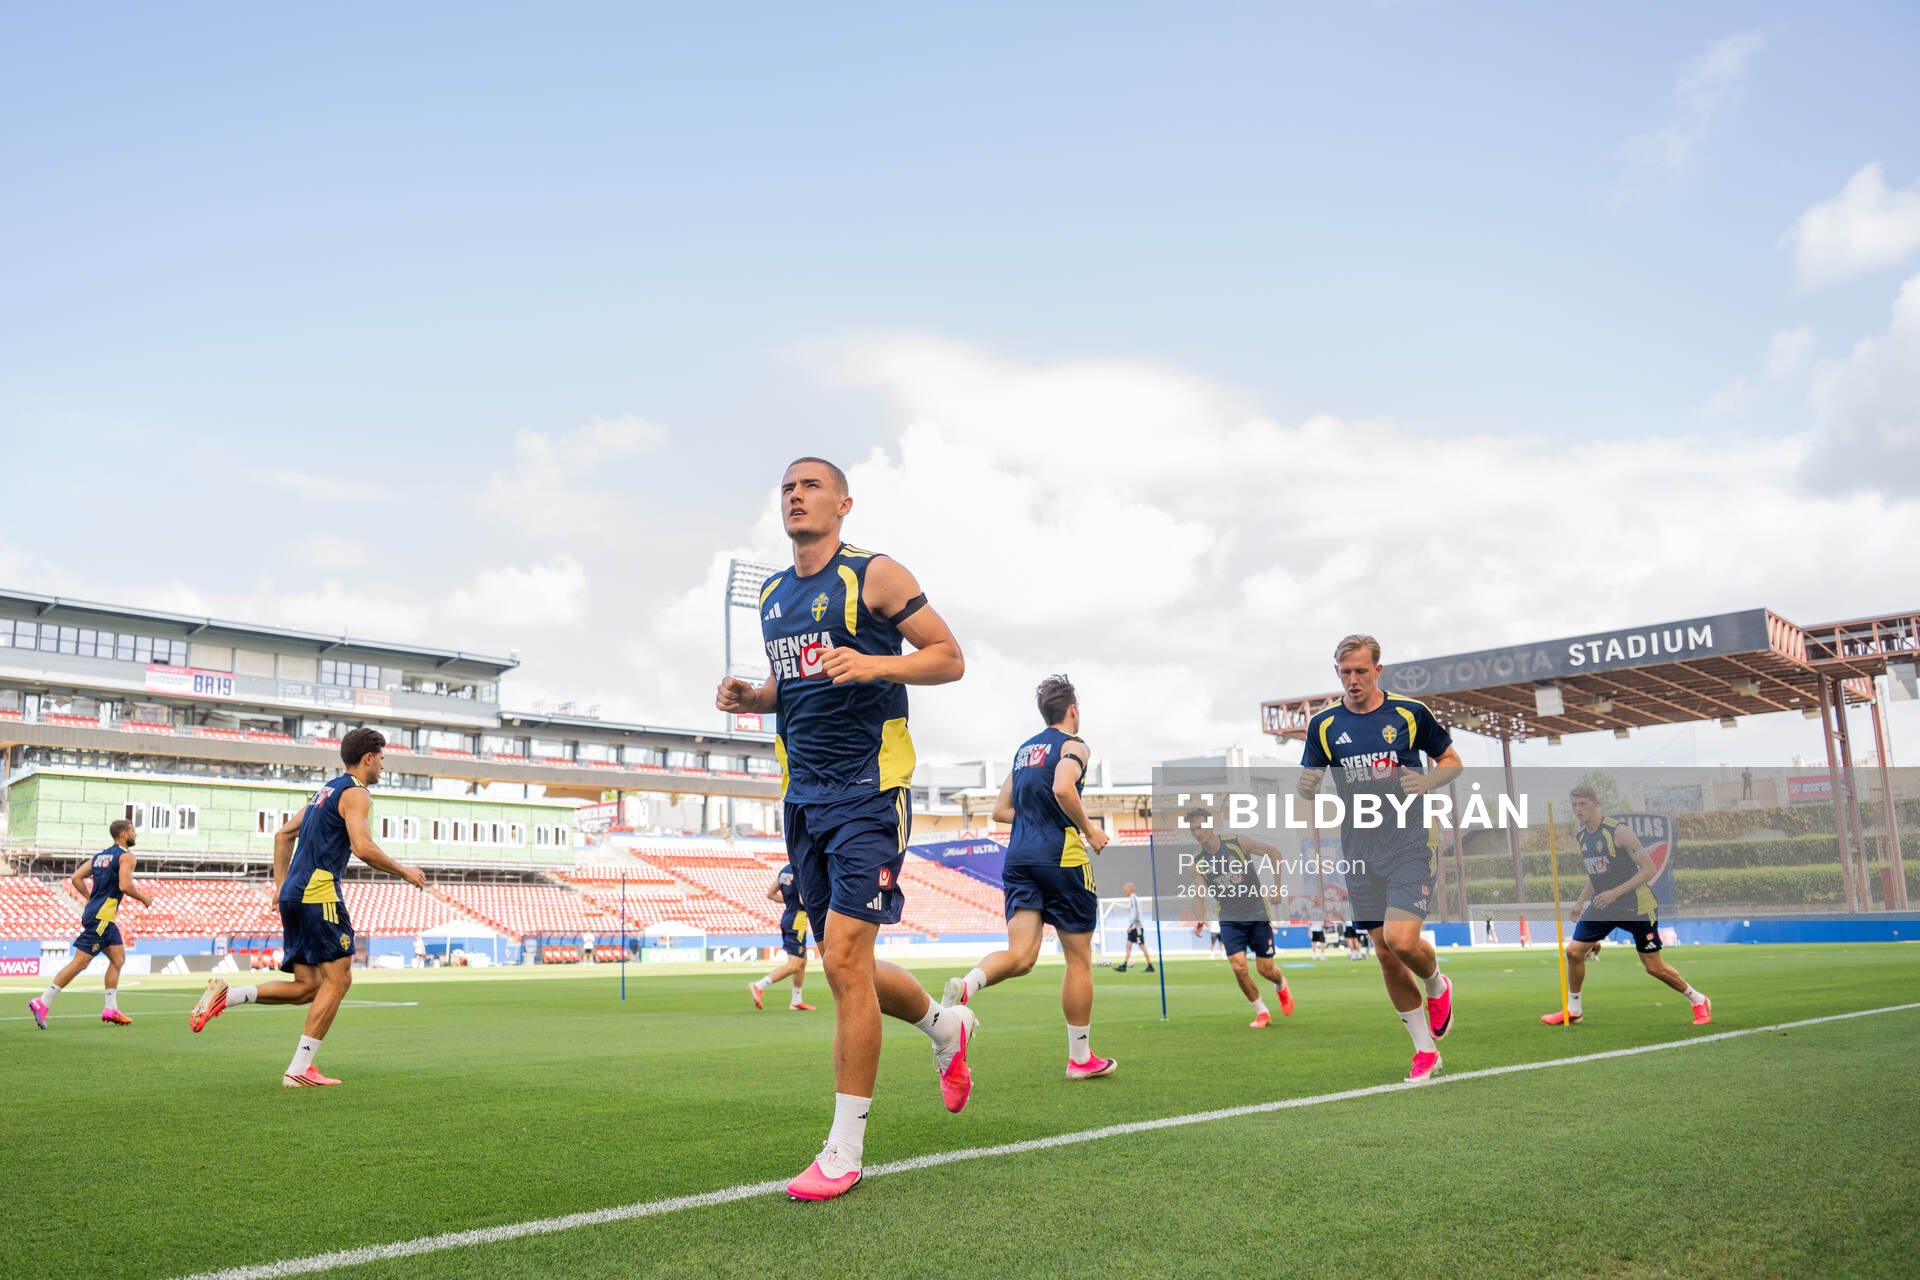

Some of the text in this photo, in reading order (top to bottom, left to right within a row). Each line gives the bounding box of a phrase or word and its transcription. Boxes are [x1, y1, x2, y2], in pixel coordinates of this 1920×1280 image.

[1440, 623, 1714, 686] TOYOTA STADIUM
[1340, 750, 1399, 771] SVENSKA
[1345, 767, 1372, 784] SPEL
[1619, 816, 1664, 838] LLAS
[972, 844, 1000, 855] ULTRA
[0, 961, 38, 975] WAYS
